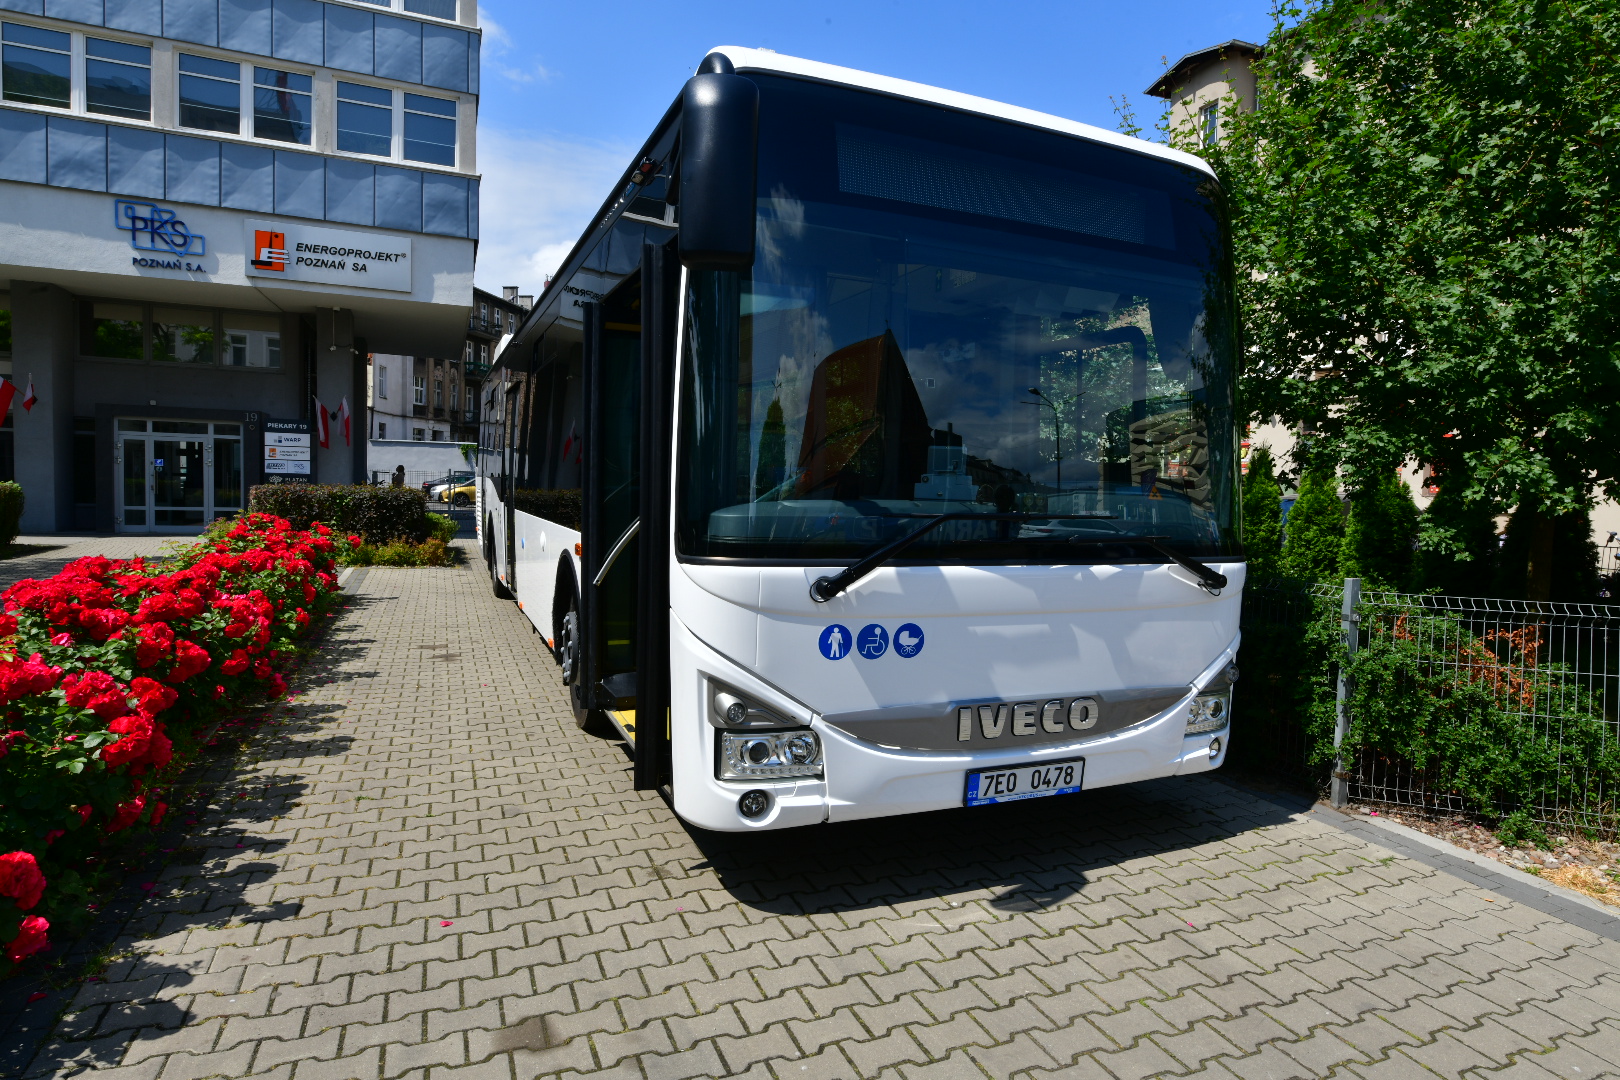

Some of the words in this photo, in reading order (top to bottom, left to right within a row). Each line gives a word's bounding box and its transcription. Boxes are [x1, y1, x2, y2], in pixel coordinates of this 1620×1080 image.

[131, 215, 189, 248] PKS
[132, 256, 182, 271] POZNAŃ
[186, 259, 207, 273] S.A.
[296, 256, 346, 271] POZNAŃ
[352, 260, 368, 273] SA
[244, 412, 258, 422] 19
[957, 696, 1099, 742] IVECO
[1031, 765, 1075, 790] 0478
[968, 790, 977, 798] CZ
